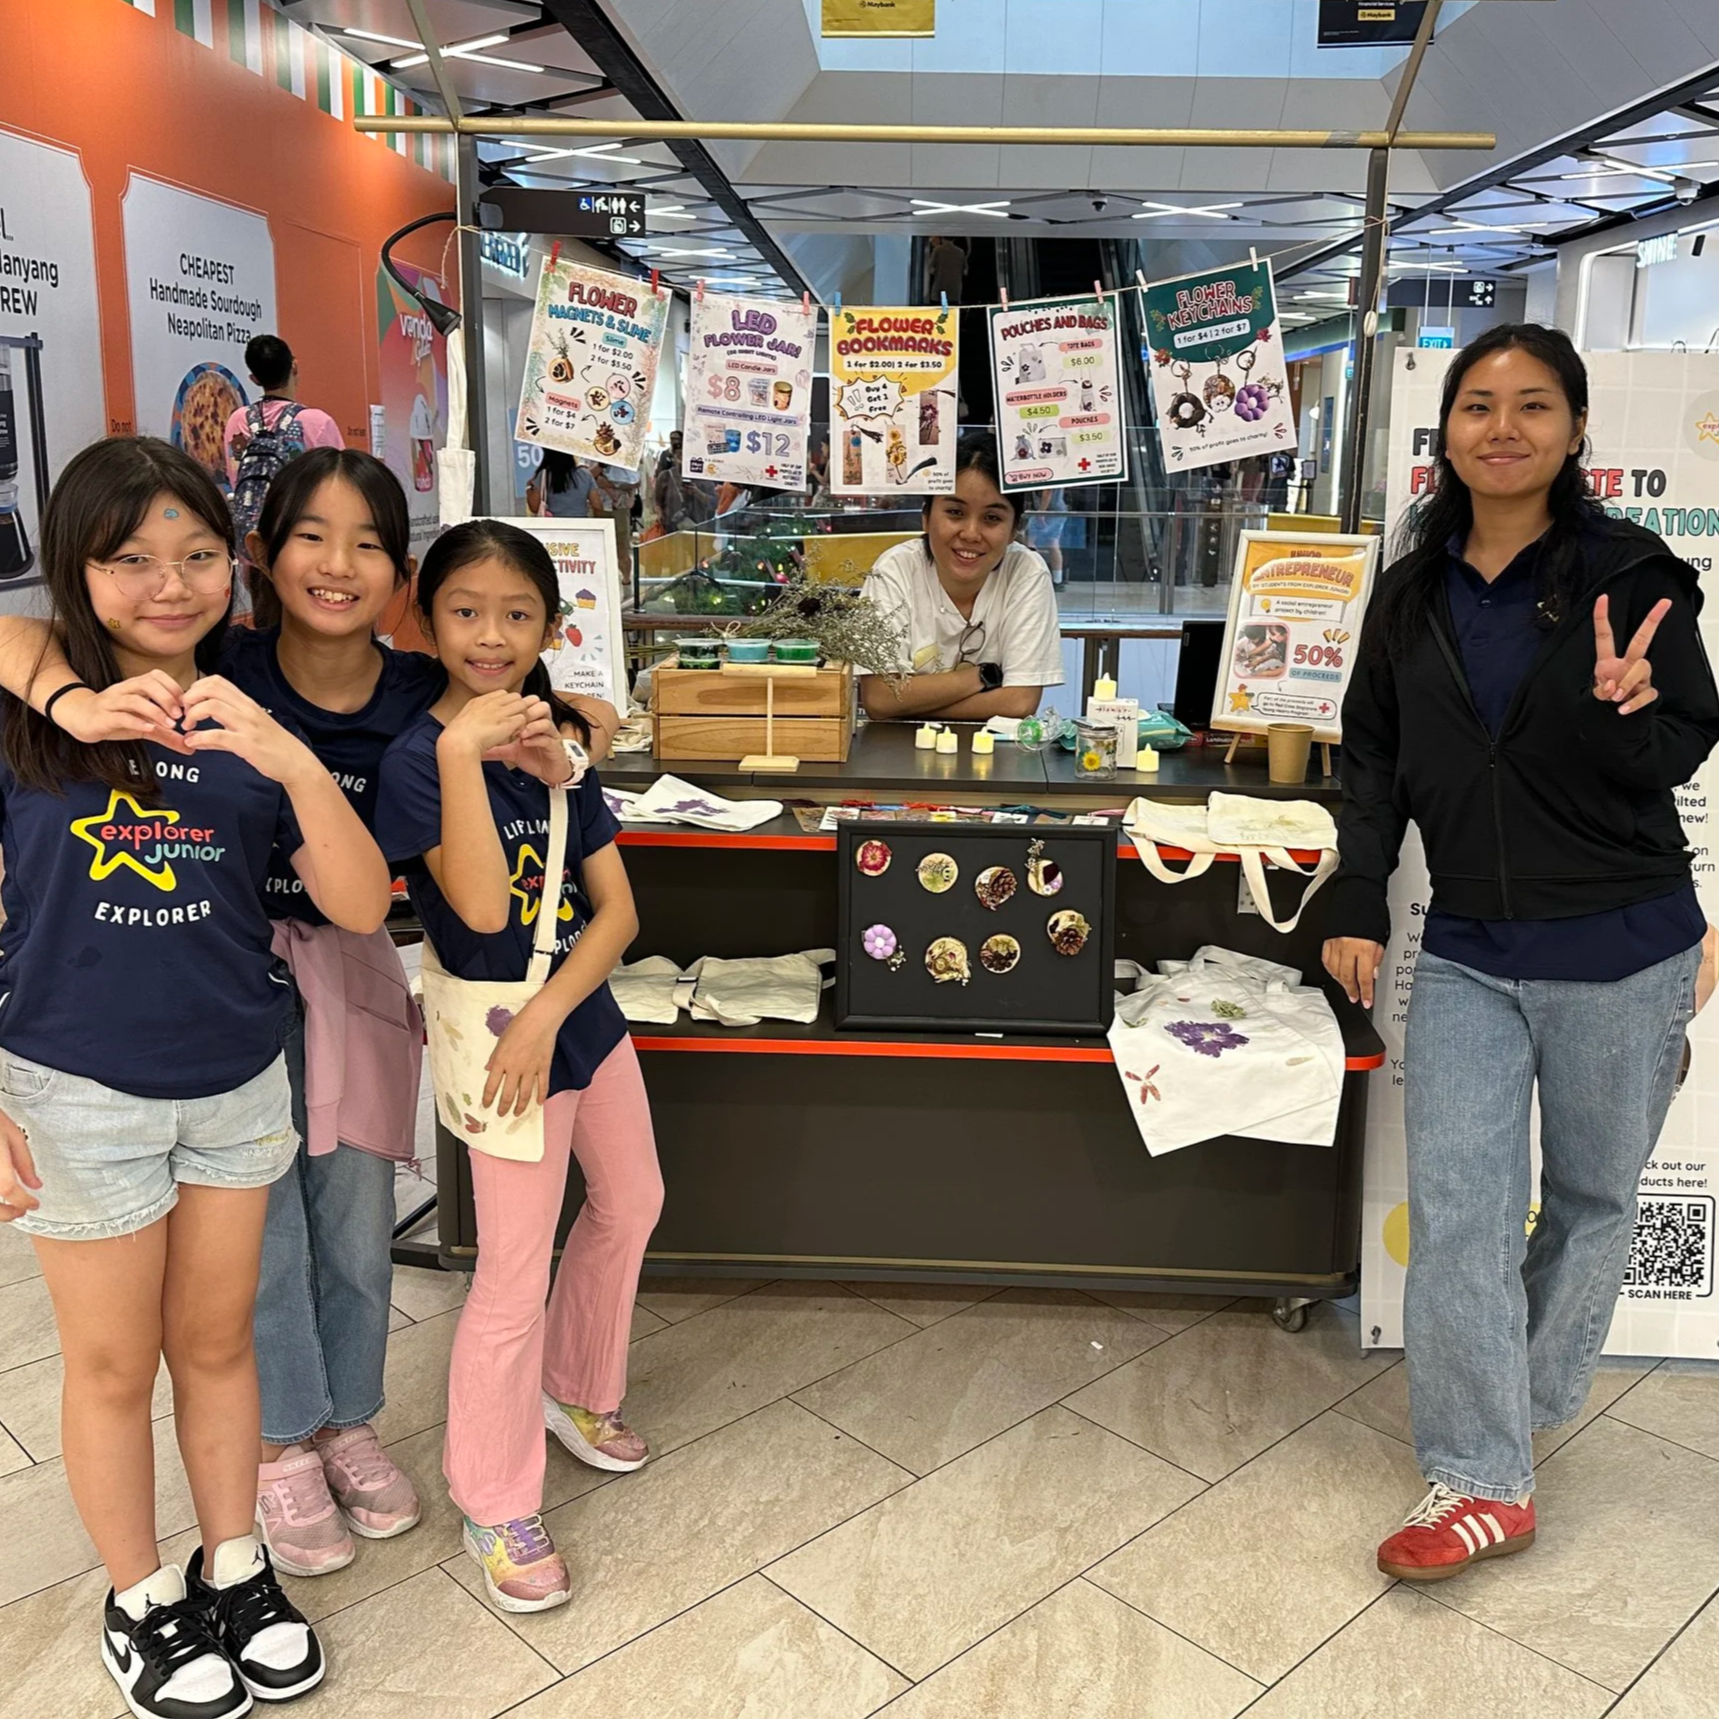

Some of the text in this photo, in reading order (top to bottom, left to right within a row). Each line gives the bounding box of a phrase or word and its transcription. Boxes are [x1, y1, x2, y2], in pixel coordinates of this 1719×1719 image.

[180, 253, 234, 285] CHEAPEST
[150, 278, 262, 322] Handmade Sourdough
[568, 281, 638, 318] FLOWER
[1175, 280, 1236, 309] FLOWER
[1167, 296, 1253, 331] KEYCHAINS
[168, 312, 251, 344] Neapolitan Pizza
[548, 304, 652, 344] MAGNETS & SLIME
[732, 309, 777, 335] LED
[855, 317, 935, 335] FLOWER
[1001, 315, 1108, 341] POUCHES AND BAGS
[1183, 334, 1197, 343] for
[1198, 332, 1209, 341] $4
[1215, 329, 1220, 337] 2
[1222, 326, 1235, 335] for
[1236, 323, 1247, 332] $7
[605, 335, 625, 346] Slime
[704, 332, 802, 359] FLOWER JAR!
[836, 335, 954, 357] BOOKMARKS
[1067, 341, 1095, 350] TOTE BAGS
[1422, 338, 1443, 348] EXIT
[598, 344, 609, 354] for
[612, 347, 634, 360] $2.00
[597, 355, 609, 366] for
[611, 358, 632, 371] $3.50
[728, 361, 776, 374] LED Candle Jars
[854, 360, 867, 368] for
[905, 360, 918, 368] for
[920, 361, 942, 369] $3.50
[1070, 357, 1095, 366] $6.00
[707, 374, 741, 402] $8
[865, 385, 880, 394] Buy
[548, 395, 579, 409] Magnets
[867, 394, 881, 403] Get
[1006, 391, 1067, 403] WATERBOTTLE HOLDERS
[552, 406, 564, 417] for
[566, 411, 576, 420] $4
[698, 406, 797, 425] Remote Controlling LED Light Jars
[1027, 406, 1051, 416] $4.50
[111, 420, 132, 432] Do not
[545, 416, 575, 430] 2 for $7
[1071, 416, 1098, 424] POUCHES
[746, 430, 790, 457] $12
[1079, 432, 1103, 442] $3.50
[1209, 440, 1225, 449] profit
[1226, 438, 1239, 446] goes
[517, 446, 544, 468] 50
[1019, 471, 1046, 480] BUY NOW
[1631, 469, 1667, 497] TO
[546, 542, 580, 557] SIVE
[1682, 557, 1712, 571] ung
[1252, 561, 1355, 587] ENTREPRENEUR
[1303, 581, 1328, 590] EXPLORER
[1297, 601, 1333, 609] entrepreneur
[1293, 644, 1343, 668] 50%
[1303, 671, 1340, 681] PROCEEDS
[565, 681, 604, 689] KEYCHAIN
[1682, 782, 1700, 791] we
[1674, 796, 1706, 807] ilted
[100, 821, 215, 850] explorer
[94, 900, 212, 927] EXPLORER
[1644, 1160, 1706, 1171] ck out our
[1639, 1176, 1708, 1188] ducts here!
[1628, 1289, 1692, 1300] SCAN HERE
